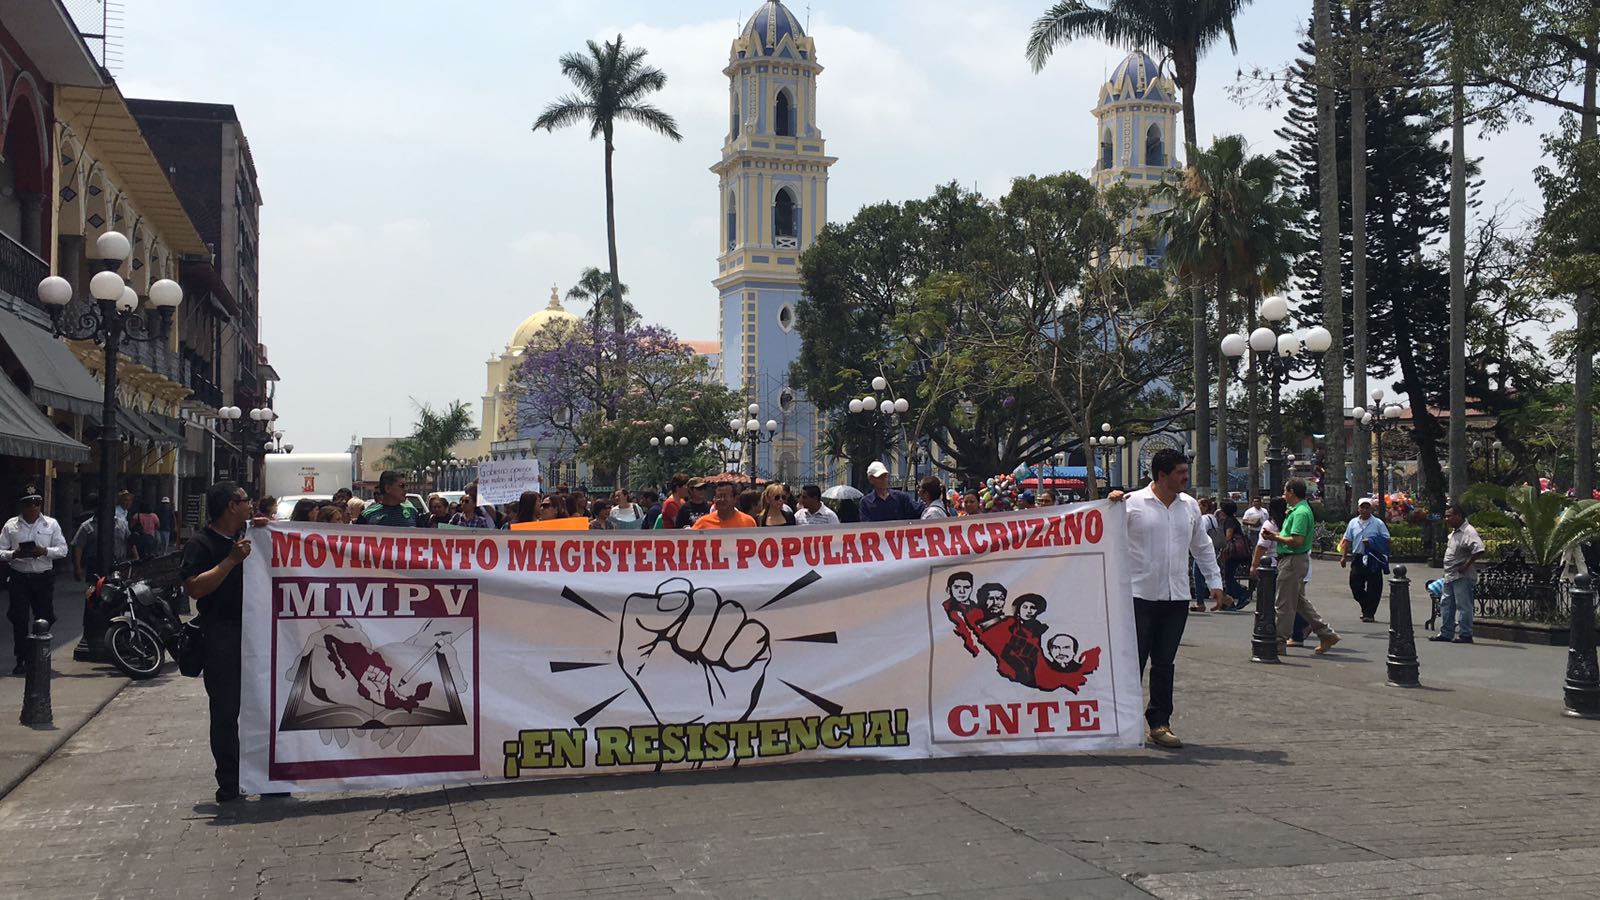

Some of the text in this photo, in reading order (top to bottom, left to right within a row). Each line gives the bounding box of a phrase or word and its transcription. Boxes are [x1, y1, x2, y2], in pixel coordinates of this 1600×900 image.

[271, 509, 1104, 573] MOVIMIENTO MAGISTERIAL POPULAR VERACRUZANO
[278, 583, 473, 617] MMPV
[503, 708, 911, 779] ¡EN RESISTENCIA!
[947, 699, 1101, 737] CNTE
